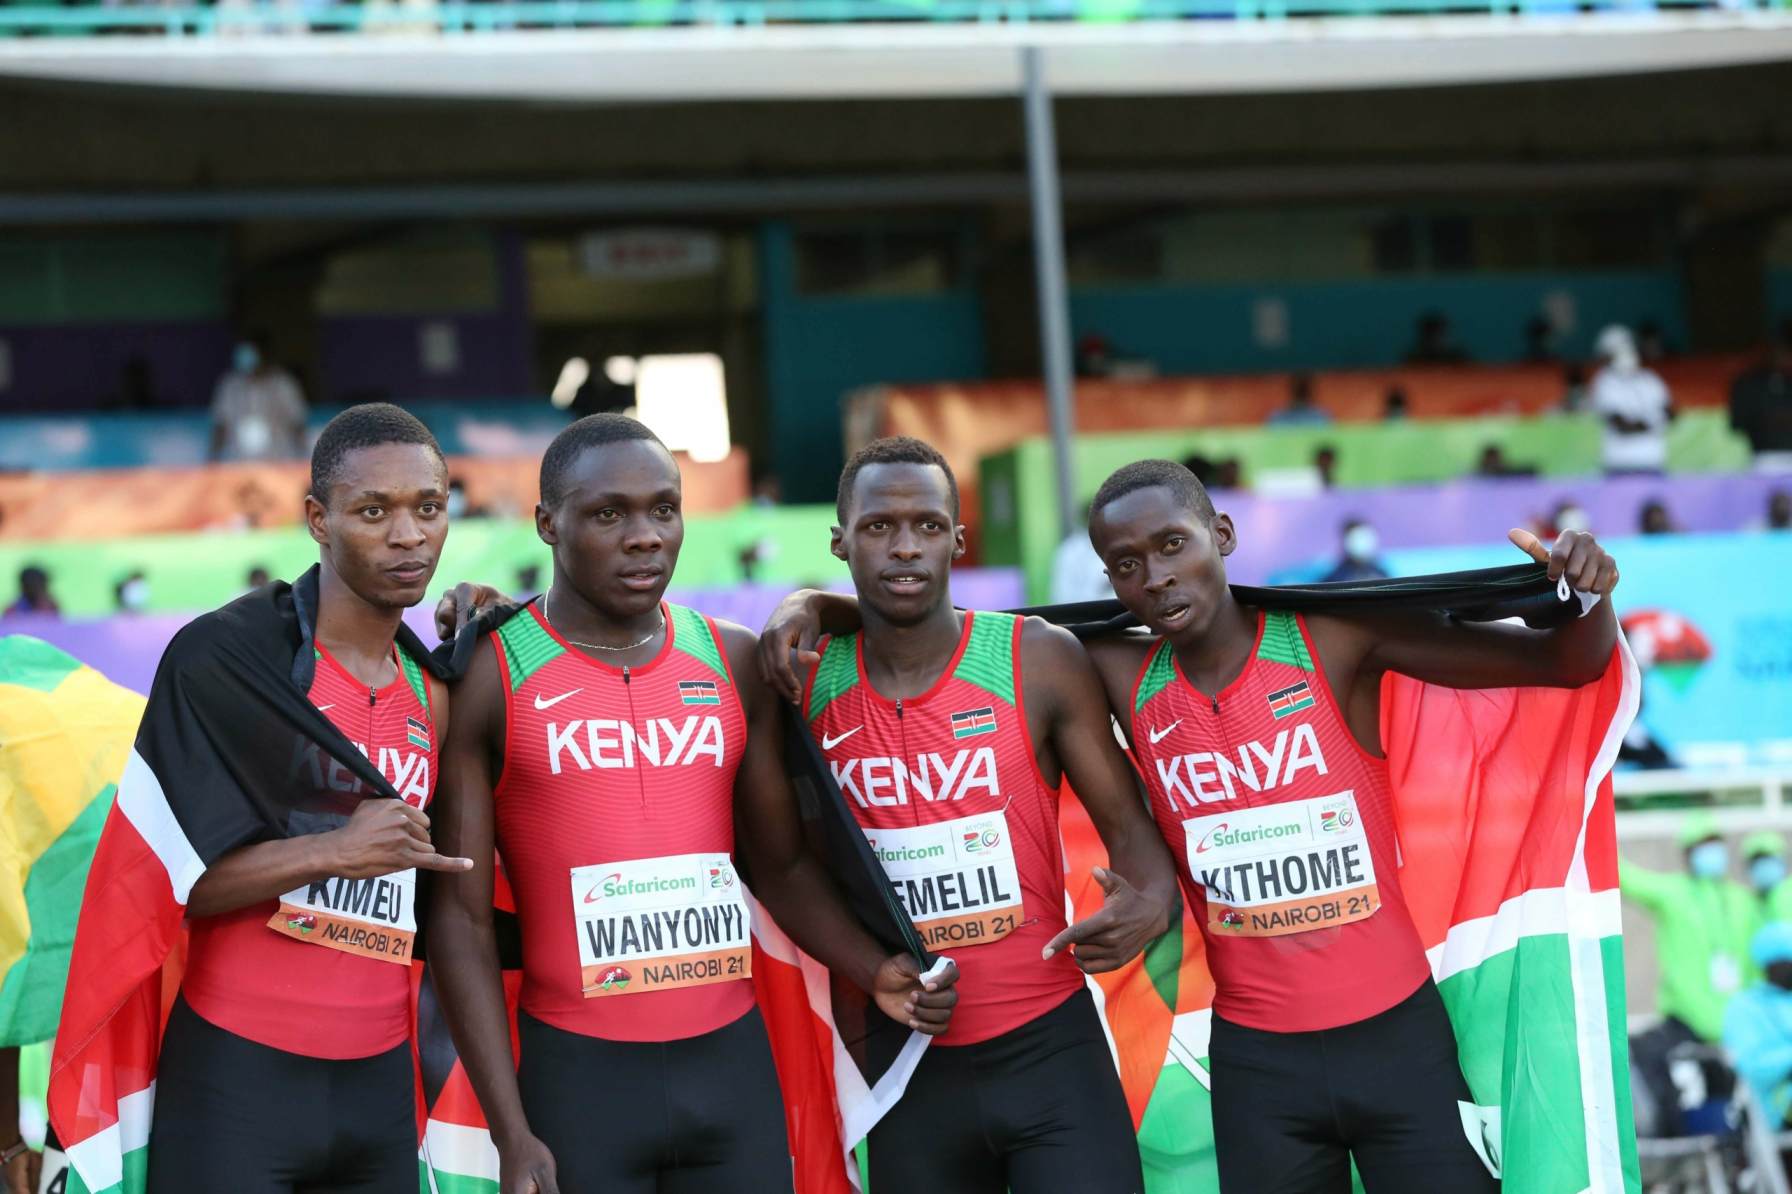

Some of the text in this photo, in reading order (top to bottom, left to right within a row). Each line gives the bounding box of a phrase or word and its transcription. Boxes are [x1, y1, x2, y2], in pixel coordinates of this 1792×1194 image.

[547, 715, 725, 775] KENYA
[830, 747, 1001, 808] KENYA
[1156, 723, 1328, 812] KENYA
[1213, 824, 1301, 847] Safaricom
[603, 876, 696, 898] Safaricom
[1201, 844, 1365, 902] KITHOME
[307, 876, 401, 923] KIMEU
[1252, 895, 1371, 930] NAIROBI 21
[322, 922, 408, 957] NAIROBI 21
[585, 903, 743, 959] WANYONYI
[991, 915, 1015, 934] 21
[643, 955, 744, 985] NAIROBI 21
